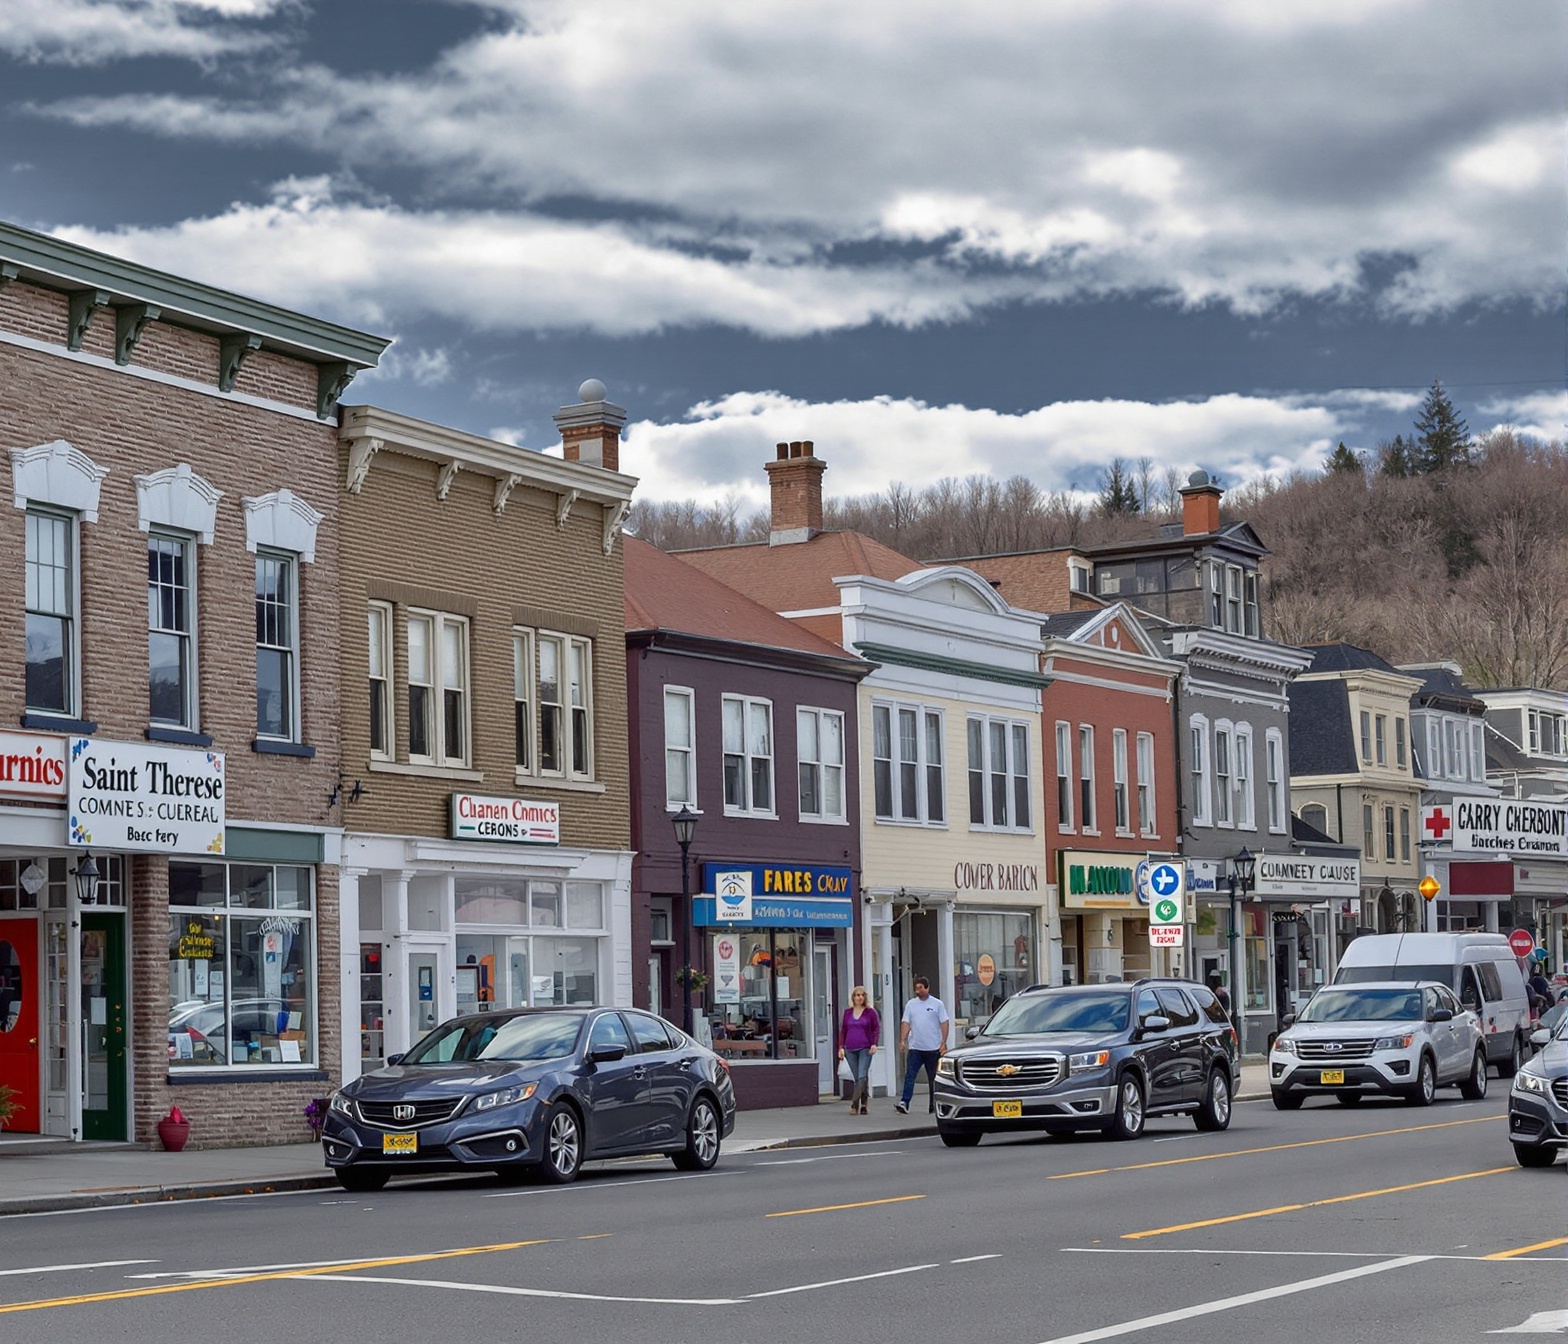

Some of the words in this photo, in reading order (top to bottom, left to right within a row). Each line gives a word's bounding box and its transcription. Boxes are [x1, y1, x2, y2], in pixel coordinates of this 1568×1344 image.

[83, 757, 139, 793] Saint
[146, 761, 223, 800] Therese
[1458, 803, 1501, 831] CARRY
[764, 869, 812, 893] FARES
